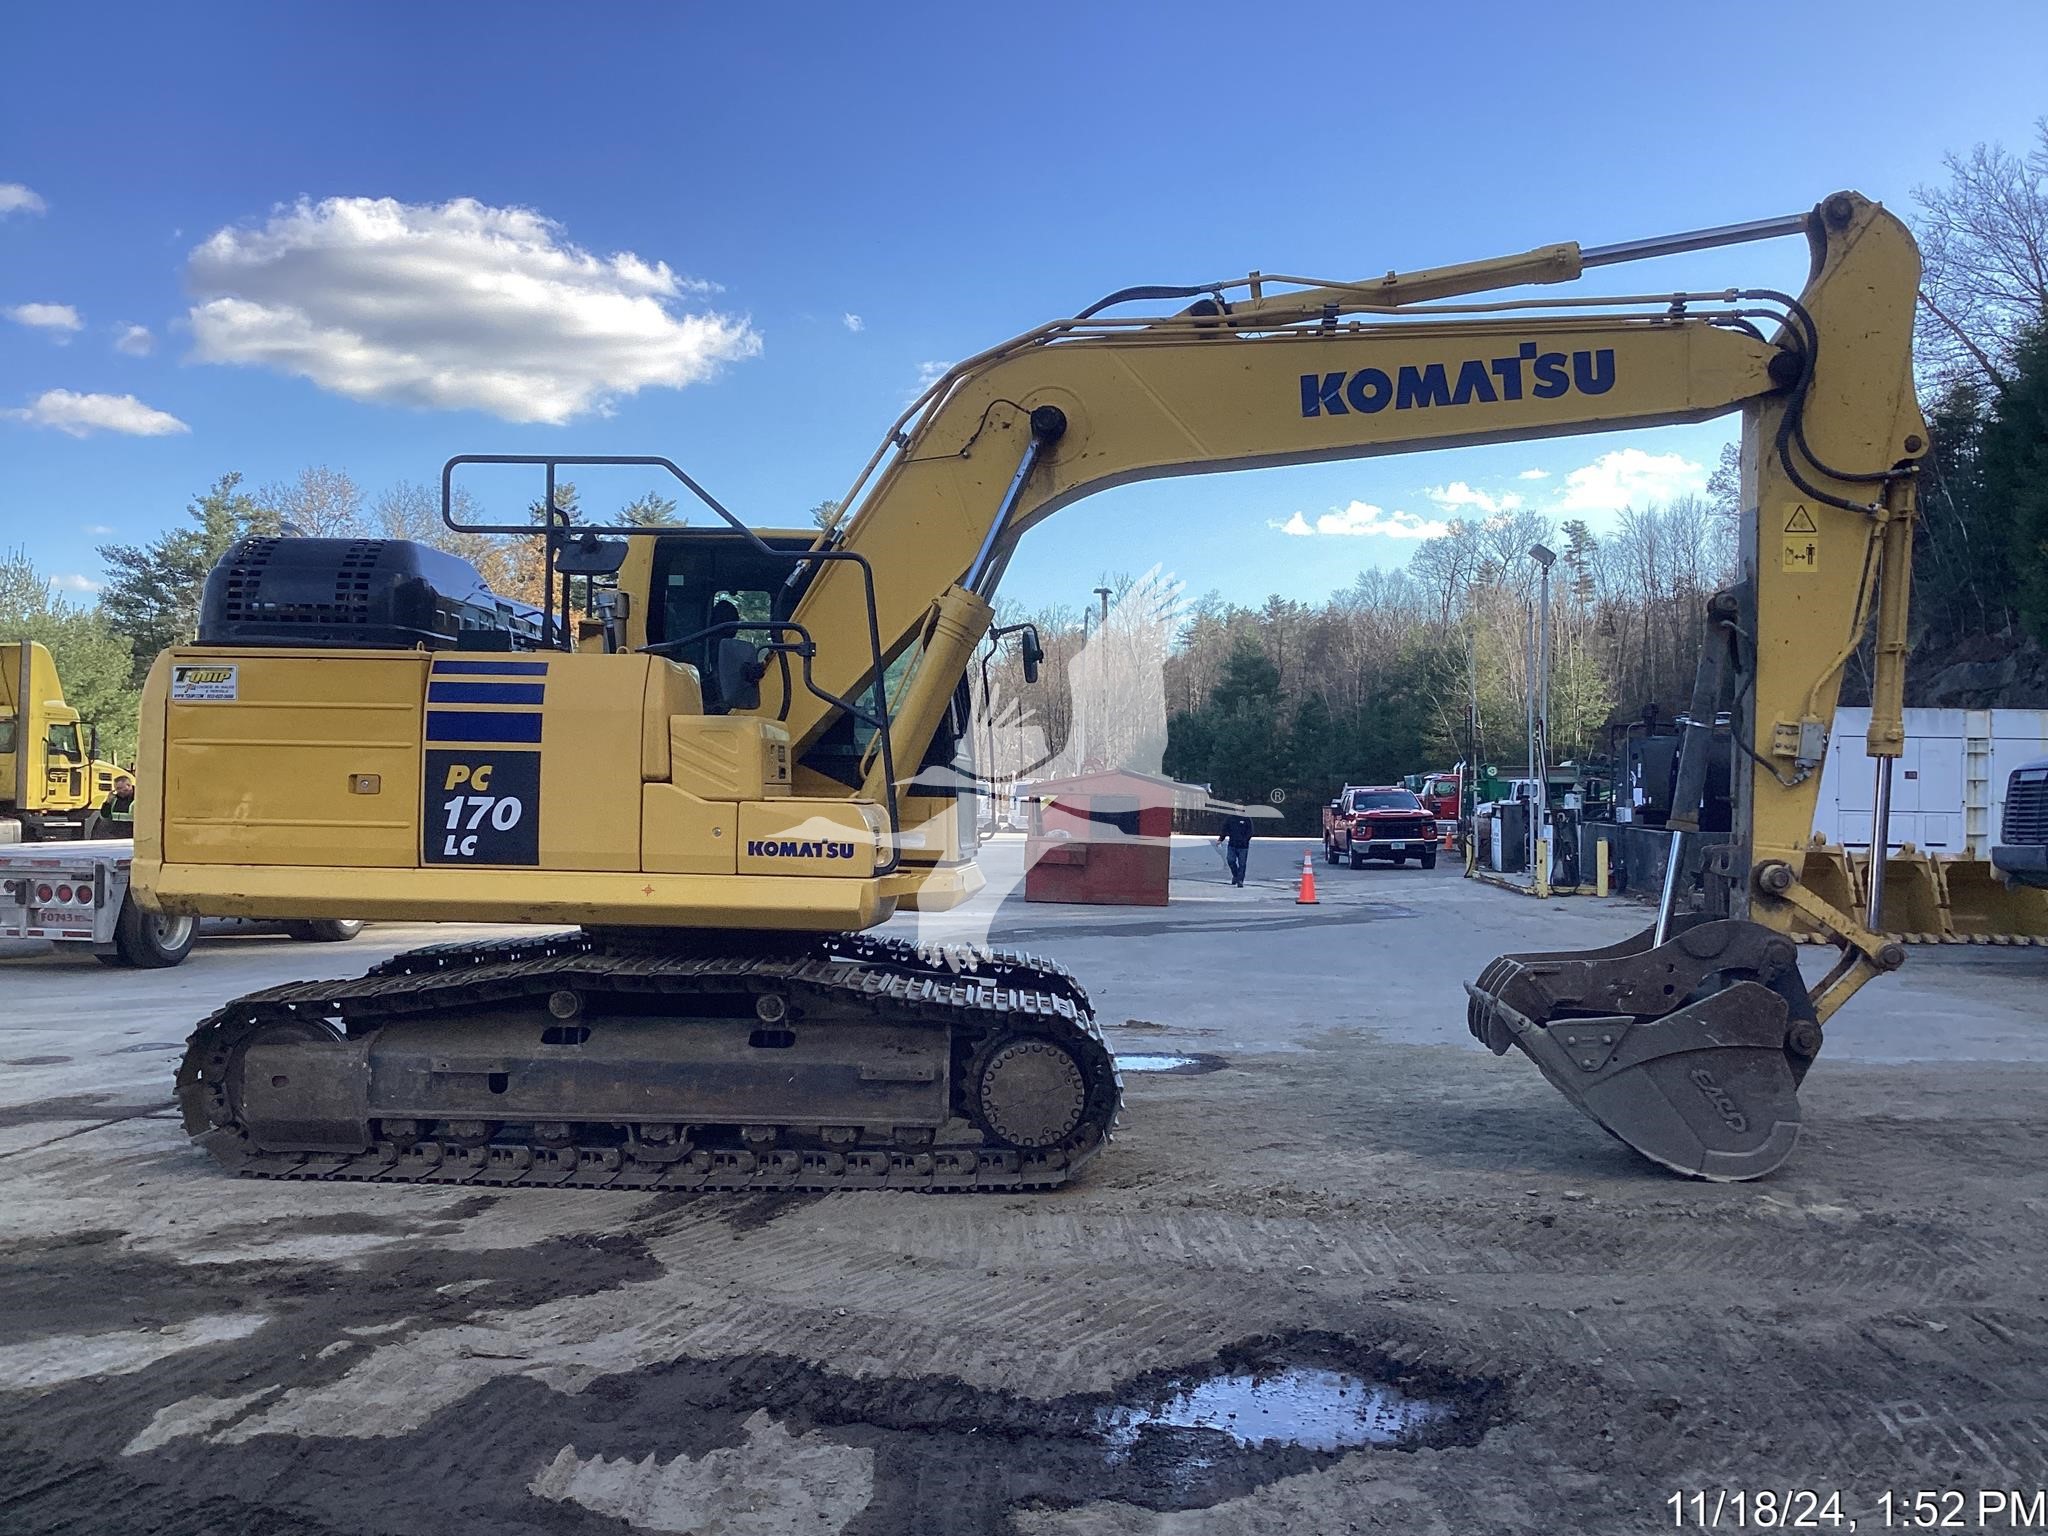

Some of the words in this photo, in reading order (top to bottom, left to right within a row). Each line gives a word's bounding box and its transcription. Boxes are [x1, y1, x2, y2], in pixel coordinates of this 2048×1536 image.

[1300, 342, 1616, 418] KOMATSU
[443, 764, 493, 791] PC
[443, 795, 522, 831] 170
[443, 834, 478, 856] LC
[748, 839, 854, 859] KOMATSU
